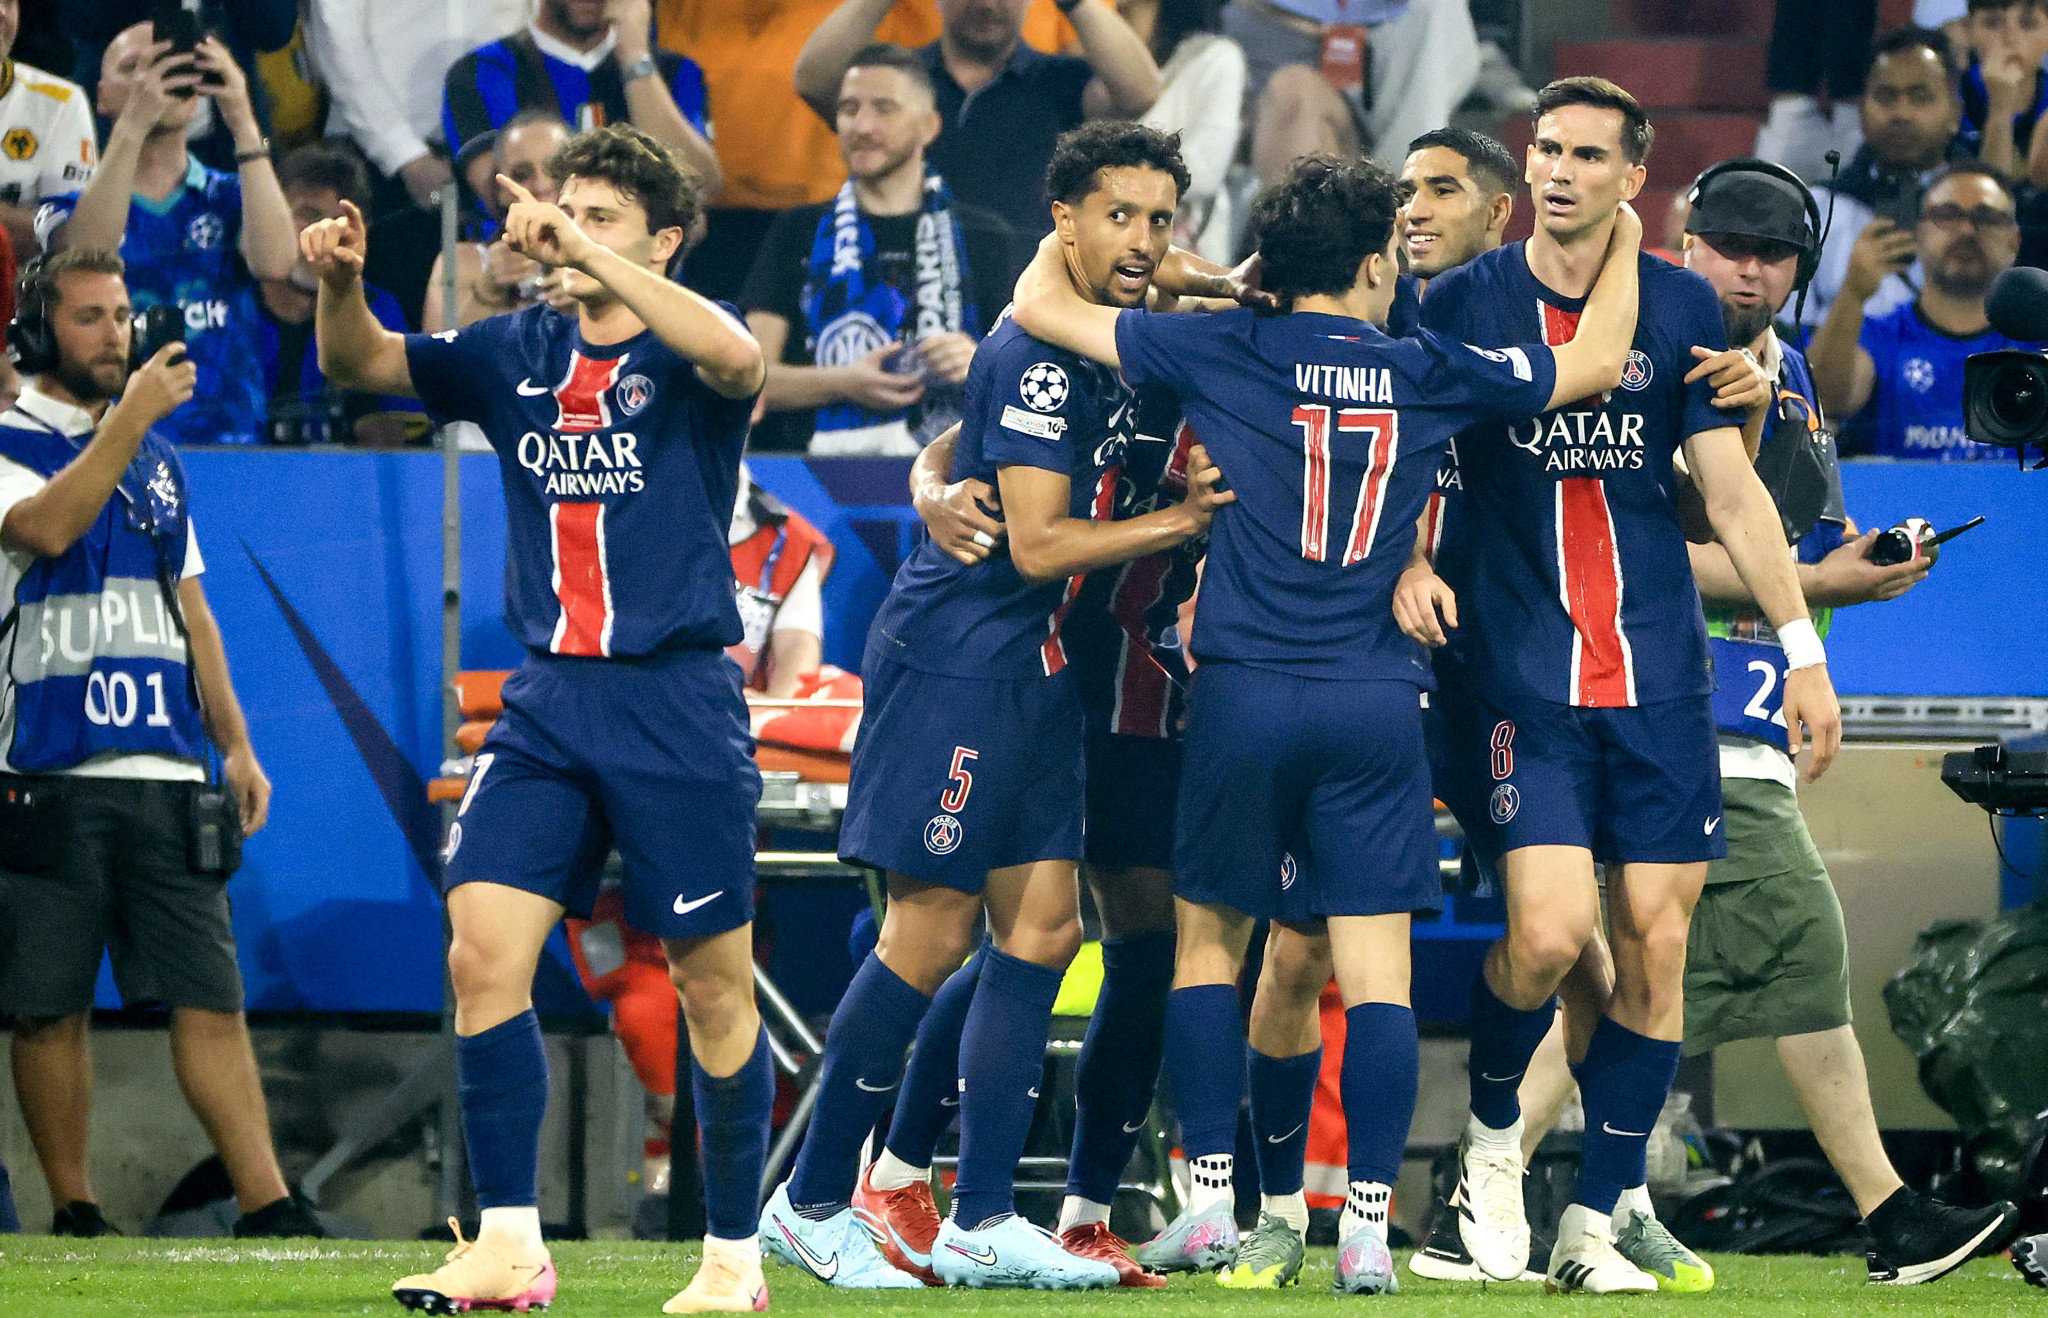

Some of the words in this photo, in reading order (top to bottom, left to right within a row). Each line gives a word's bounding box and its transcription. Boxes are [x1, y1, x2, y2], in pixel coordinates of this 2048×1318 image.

[1295, 363, 1393, 404] VITINHA
[517, 431, 643, 477] QATAR
[1508, 412, 1645, 456] QATAR
[544, 469, 645, 495] AIRWAYS
[1545, 448, 1644, 472] AIRWAYS
[1291, 403, 1399, 567] 17
[84, 670, 170, 727] 001
[1490, 720, 1515, 780] 8
[940, 745, 979, 813] 5
[933, 817, 958, 829] PARIS
